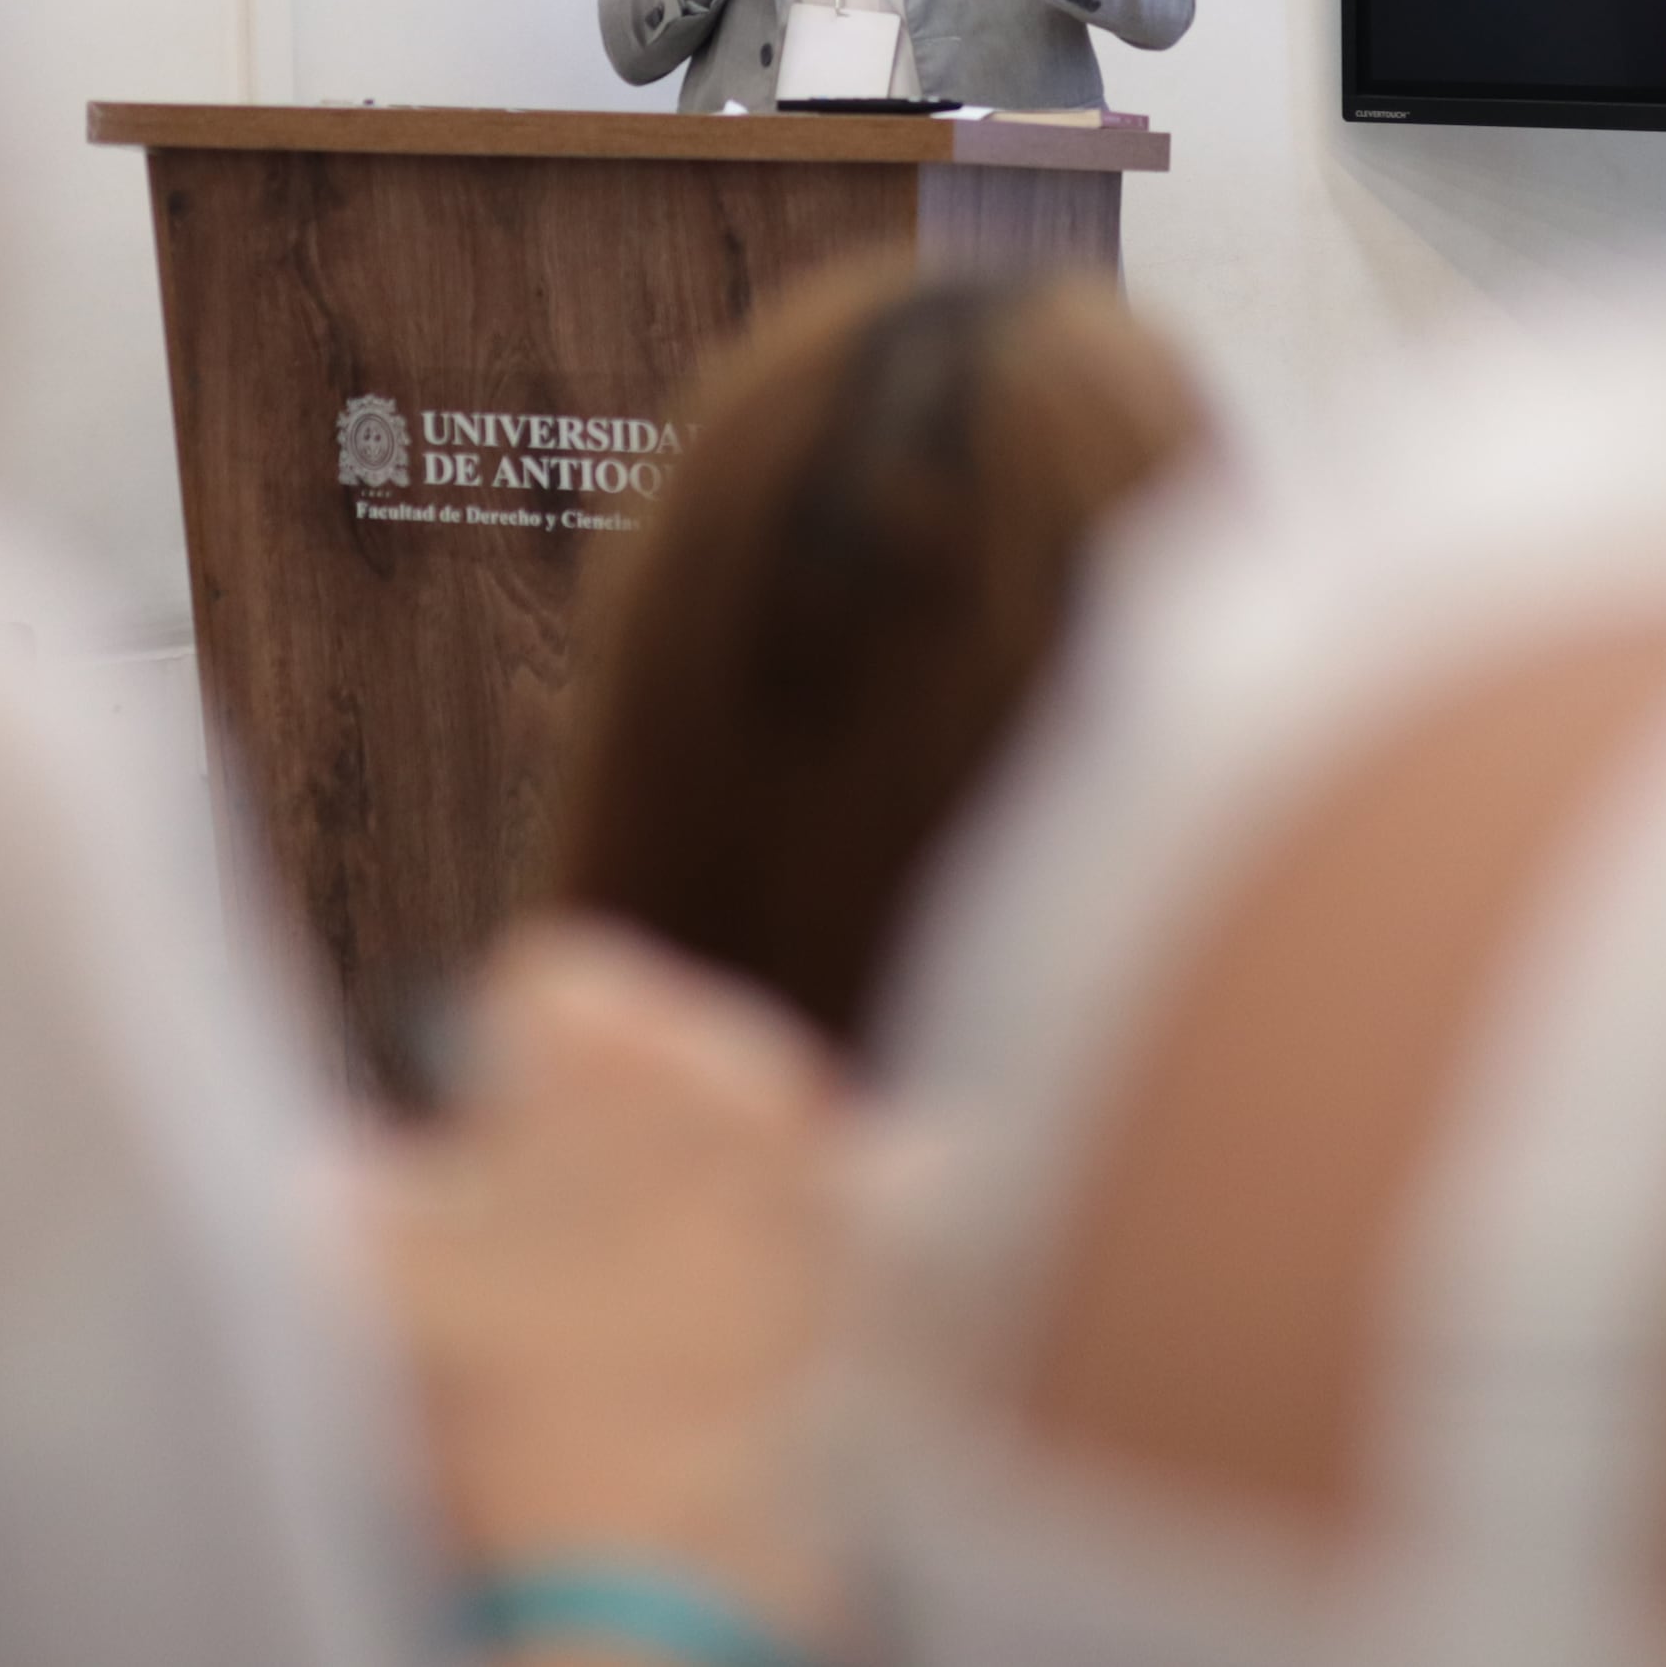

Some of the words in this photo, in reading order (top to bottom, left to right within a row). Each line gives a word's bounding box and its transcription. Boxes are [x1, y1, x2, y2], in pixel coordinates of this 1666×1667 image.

[422, 451, 483, 487] DE
[491, 454, 675, 502] ANTIOQ
[355, 501, 435, 522] Facultad
[439, 504, 461, 523] de
[465, 505, 542, 527] Derecho
[545, 513, 557, 532] y
